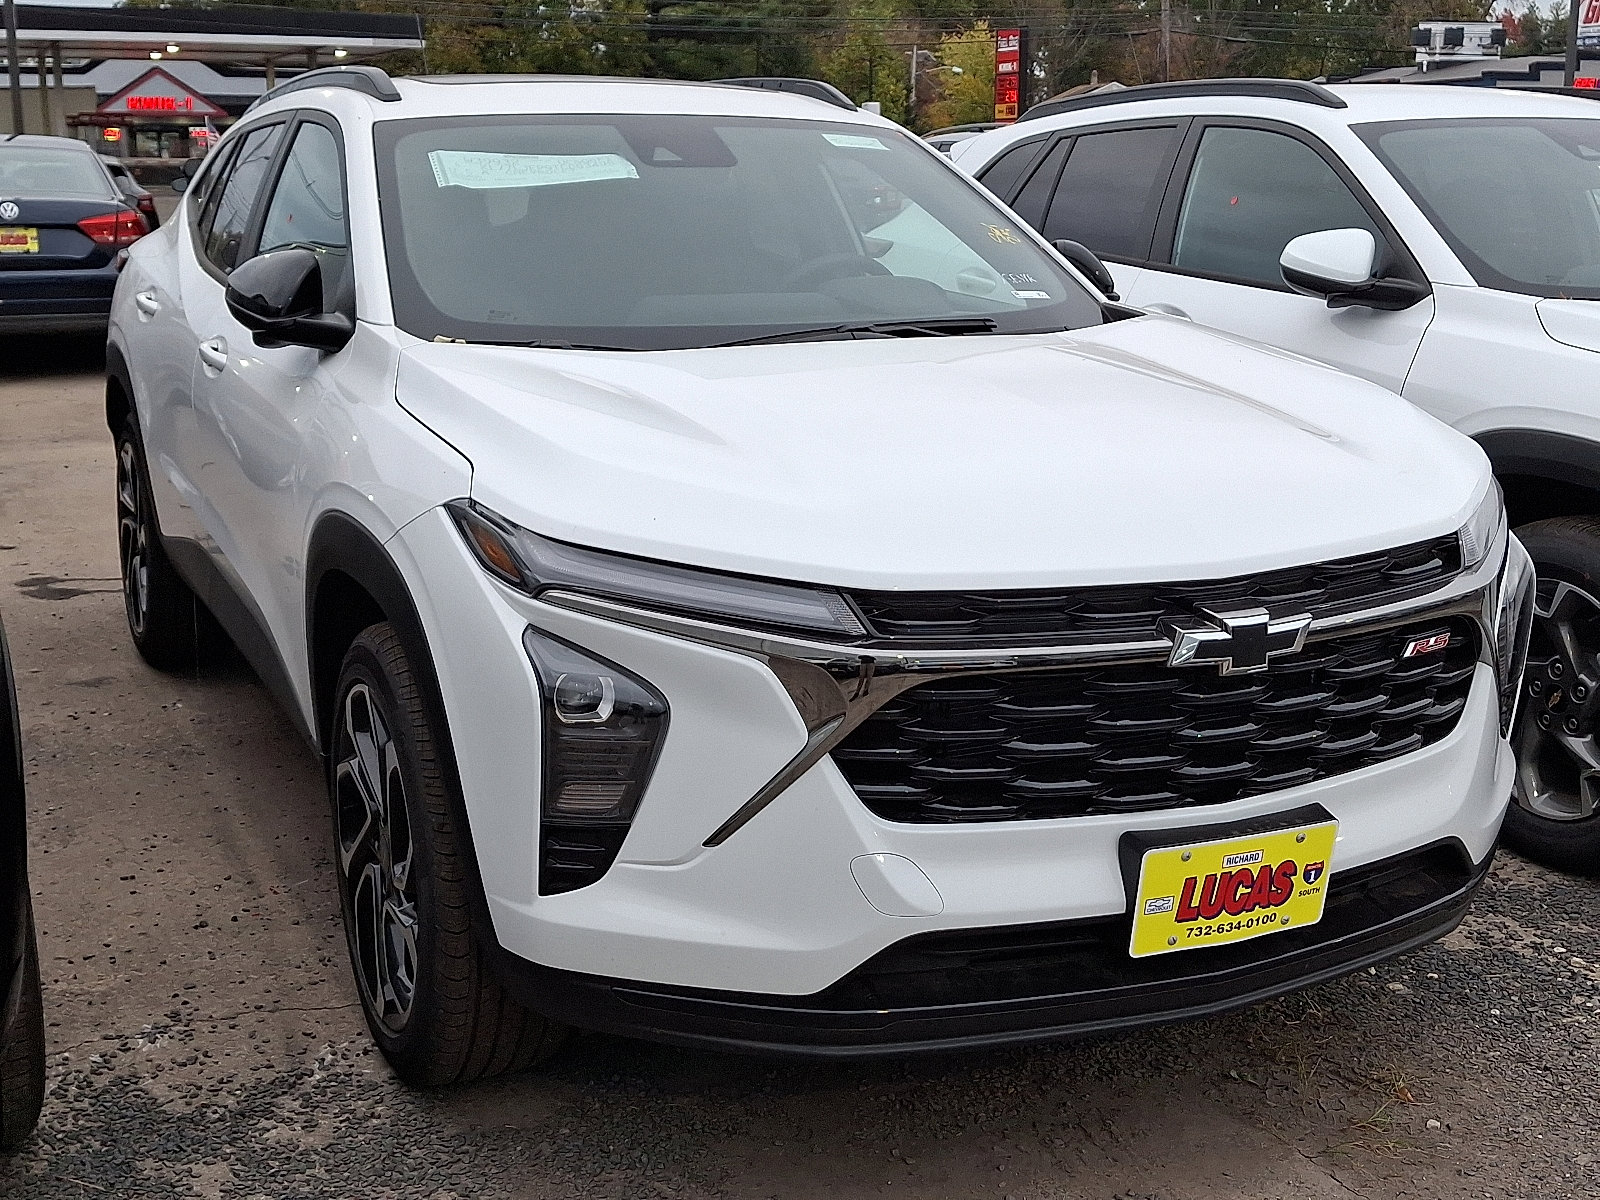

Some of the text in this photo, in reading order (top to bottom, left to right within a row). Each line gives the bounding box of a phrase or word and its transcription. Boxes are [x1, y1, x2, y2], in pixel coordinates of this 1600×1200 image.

[1403, 632, 1451, 658] RS
[1226, 852, 1260, 866] RICHARD
[1175, 860, 1298, 923] LUCAS
[1298, 886, 1321, 898] SOUTH
[1185, 912, 1277, 939] 732-634-0100
